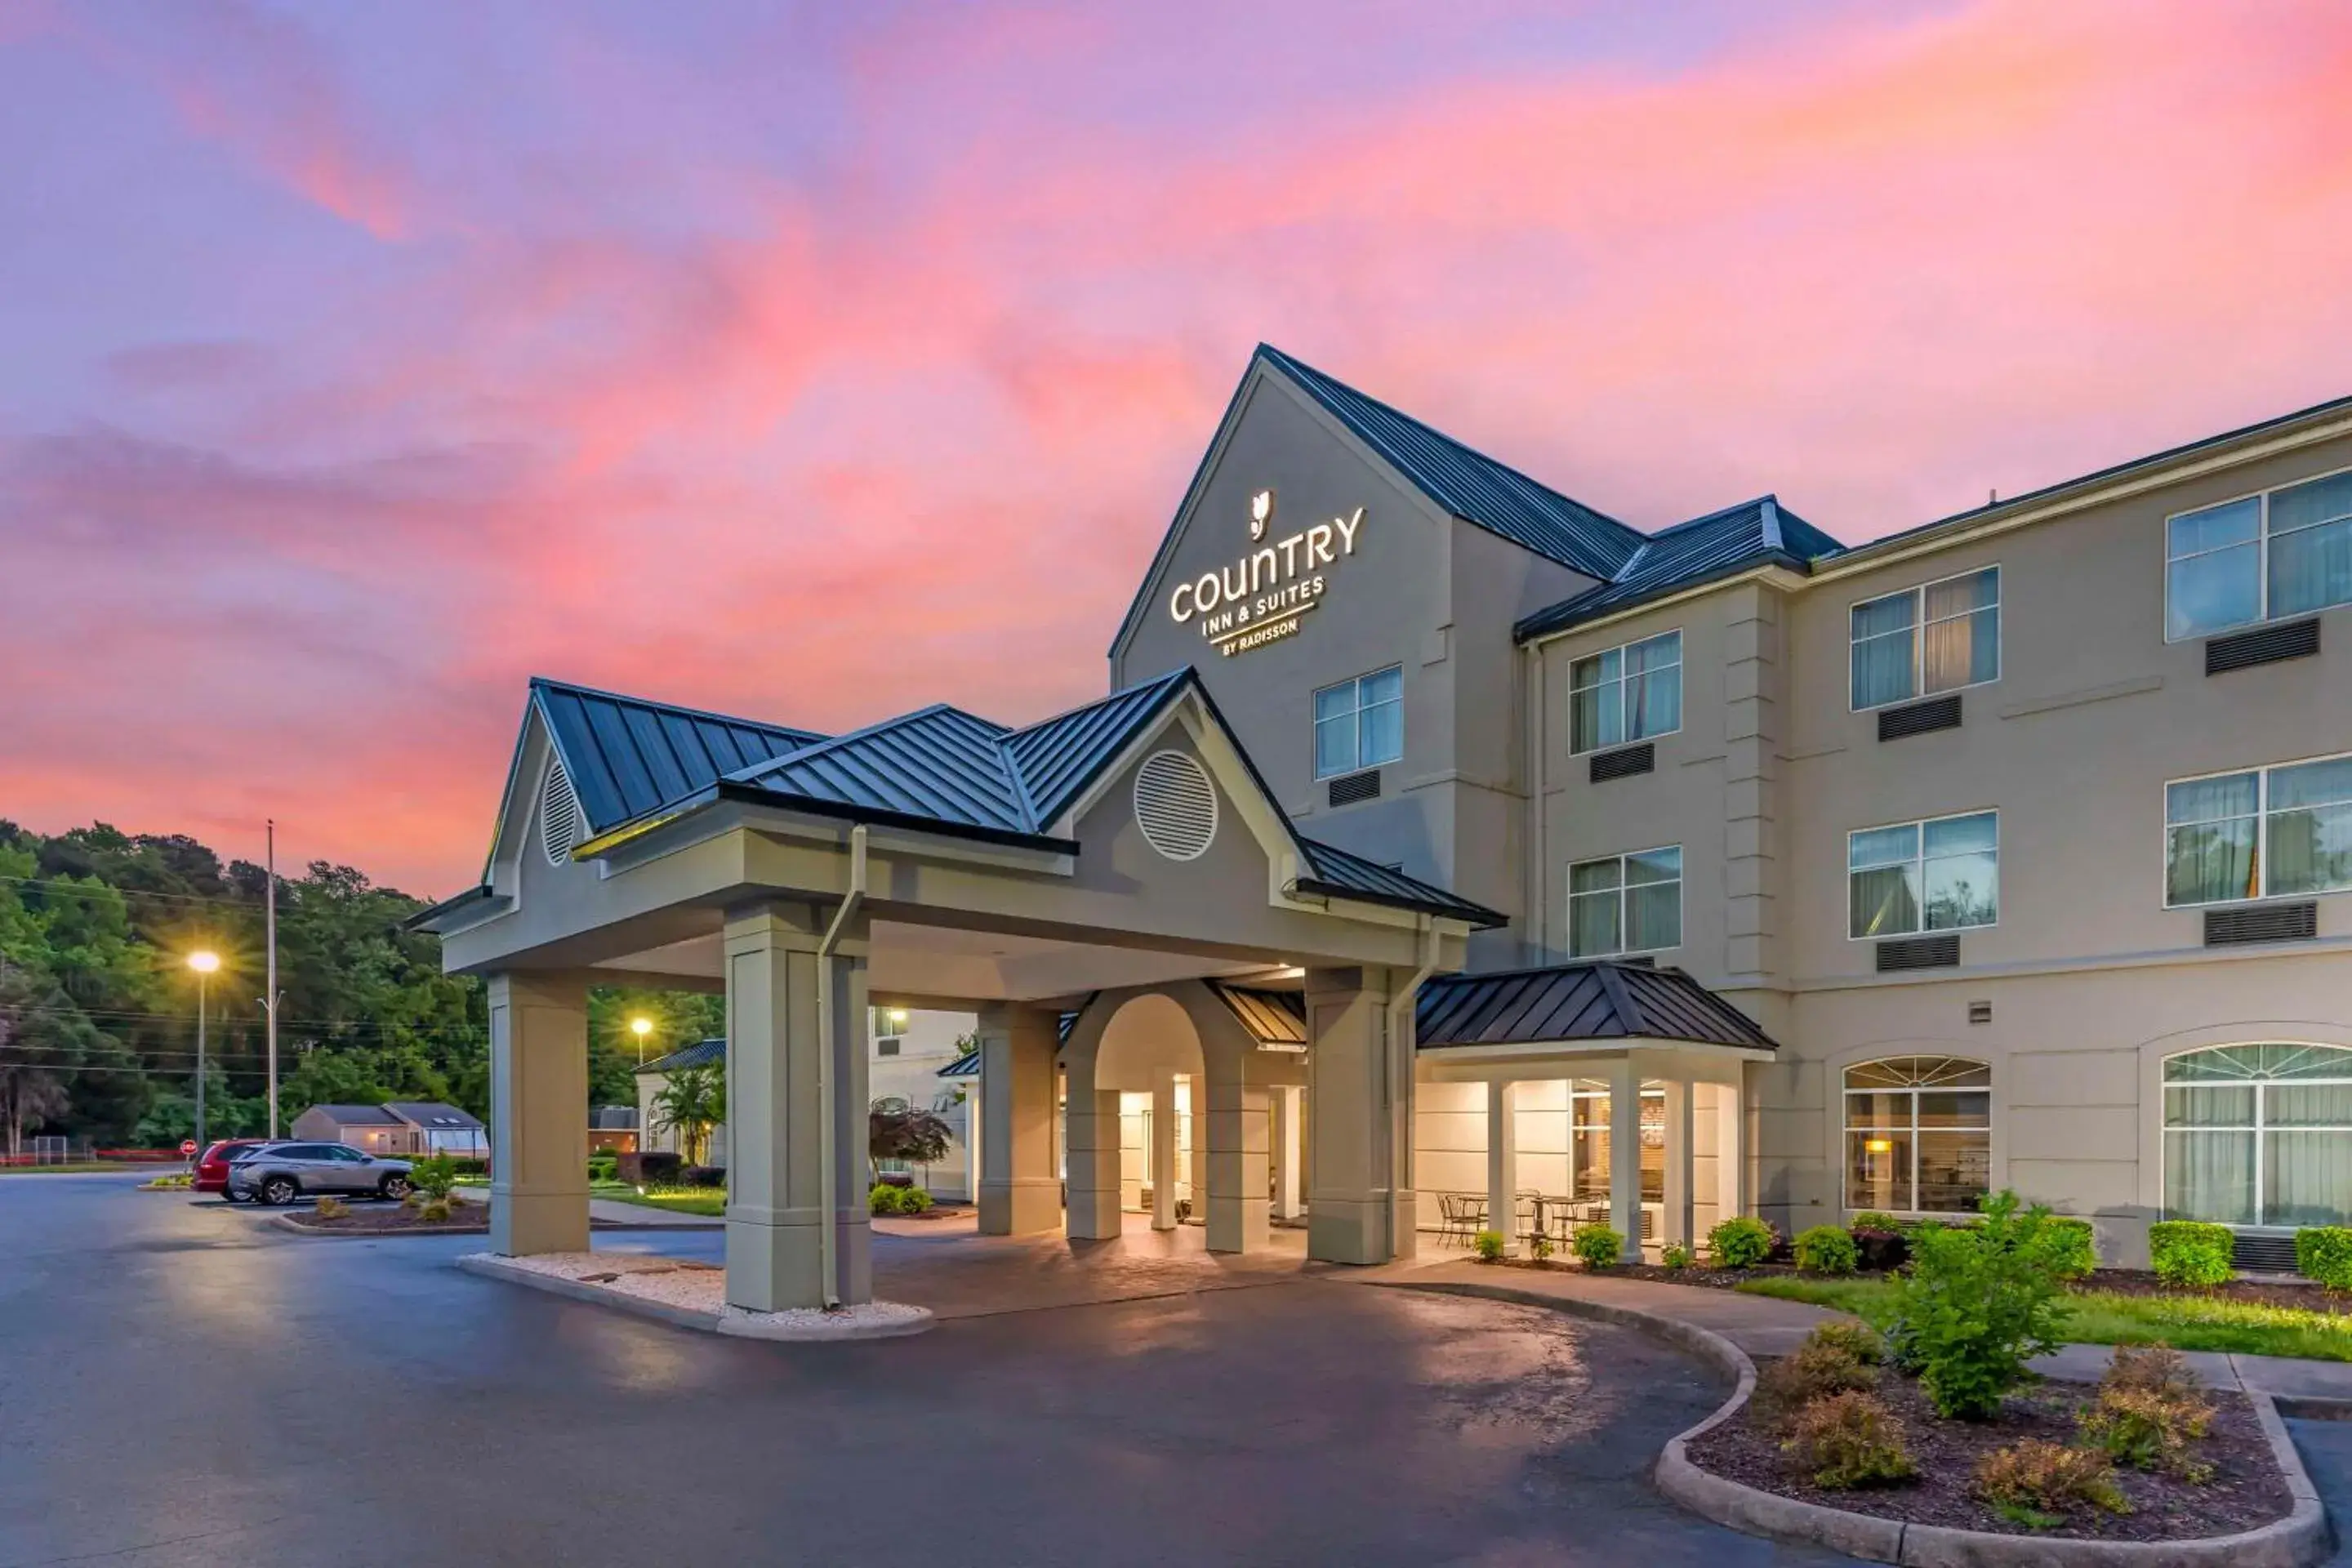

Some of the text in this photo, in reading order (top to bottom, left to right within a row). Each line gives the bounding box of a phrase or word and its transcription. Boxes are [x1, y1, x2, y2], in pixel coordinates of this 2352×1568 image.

[1201, 576, 1324, 637] INN & SUITES
[1223, 618, 1298, 657] BY RADISSON
